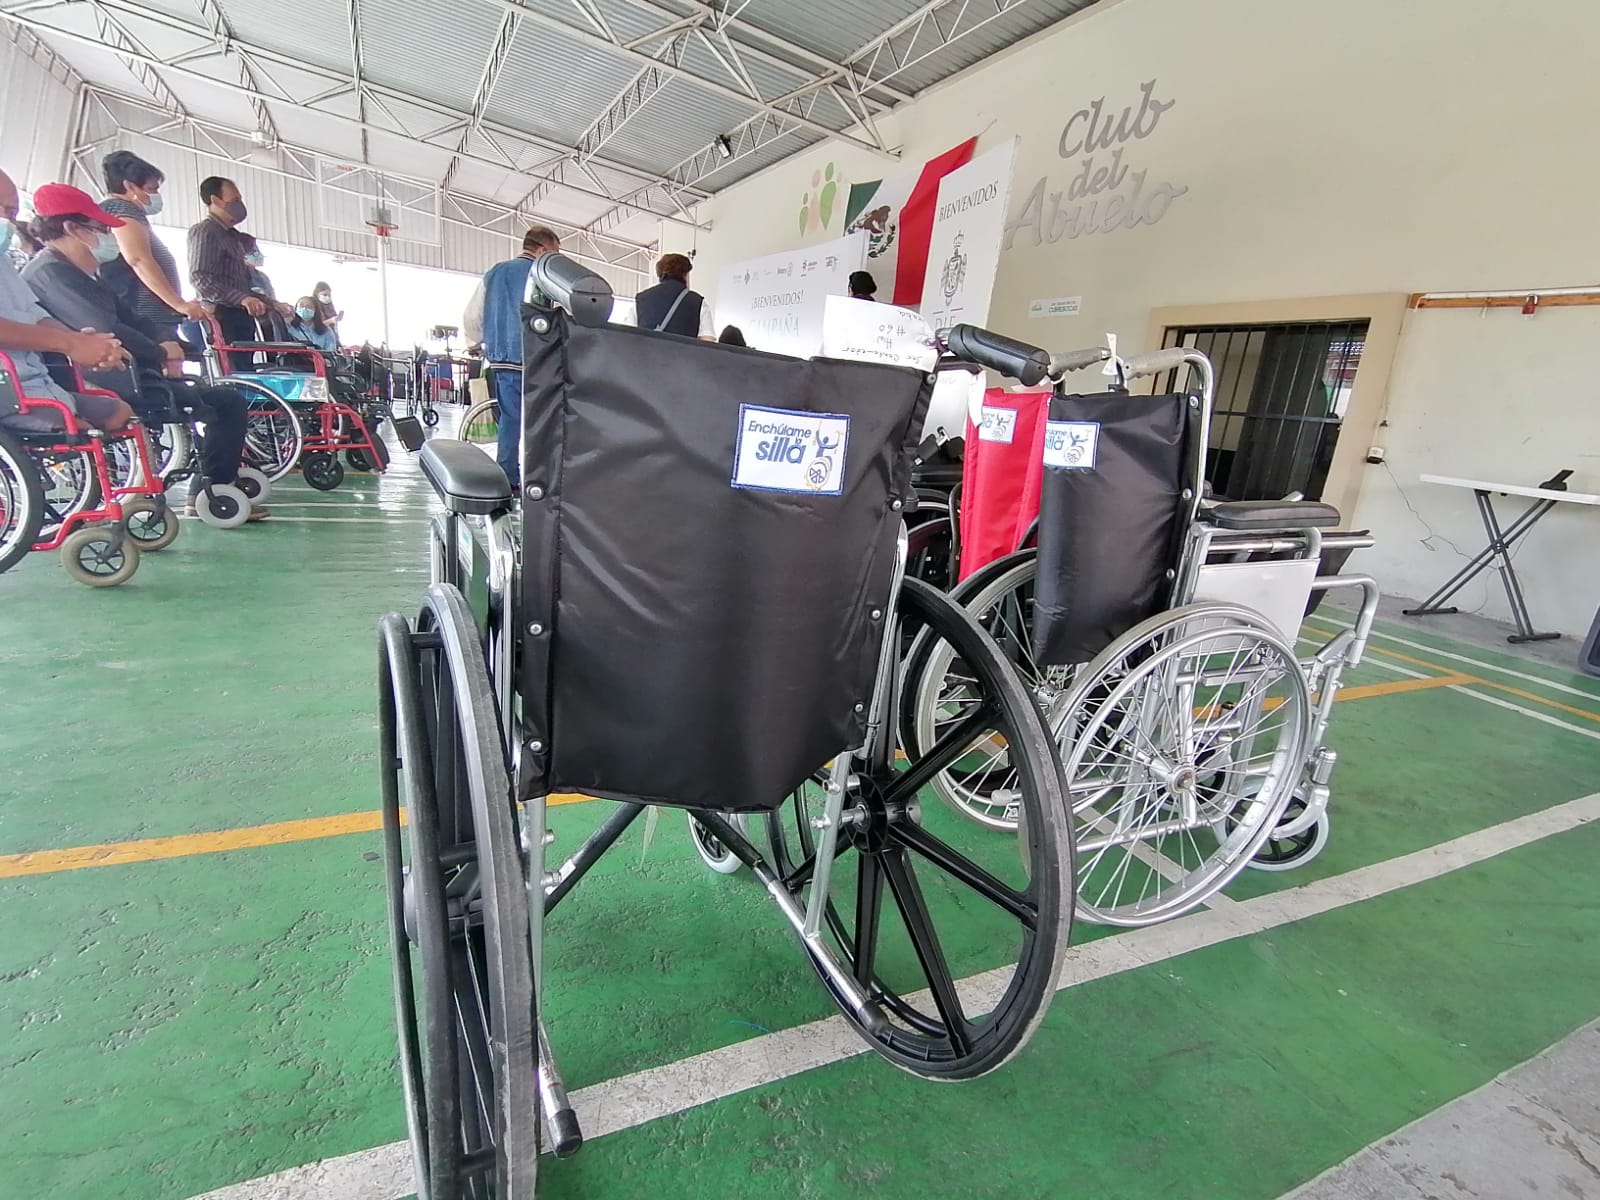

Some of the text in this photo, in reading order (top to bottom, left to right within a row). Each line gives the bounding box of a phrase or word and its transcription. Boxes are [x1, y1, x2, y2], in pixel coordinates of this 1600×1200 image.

[1059, 78, 1175, 158] Club
[1068, 147, 1128, 201] del
[938, 181, 999, 222] BIENVENIDOS
[1004, 168, 1188, 250] Abuelo
[748, 420, 812, 438] Enchúlame
[755, 436, 806, 464] silla
